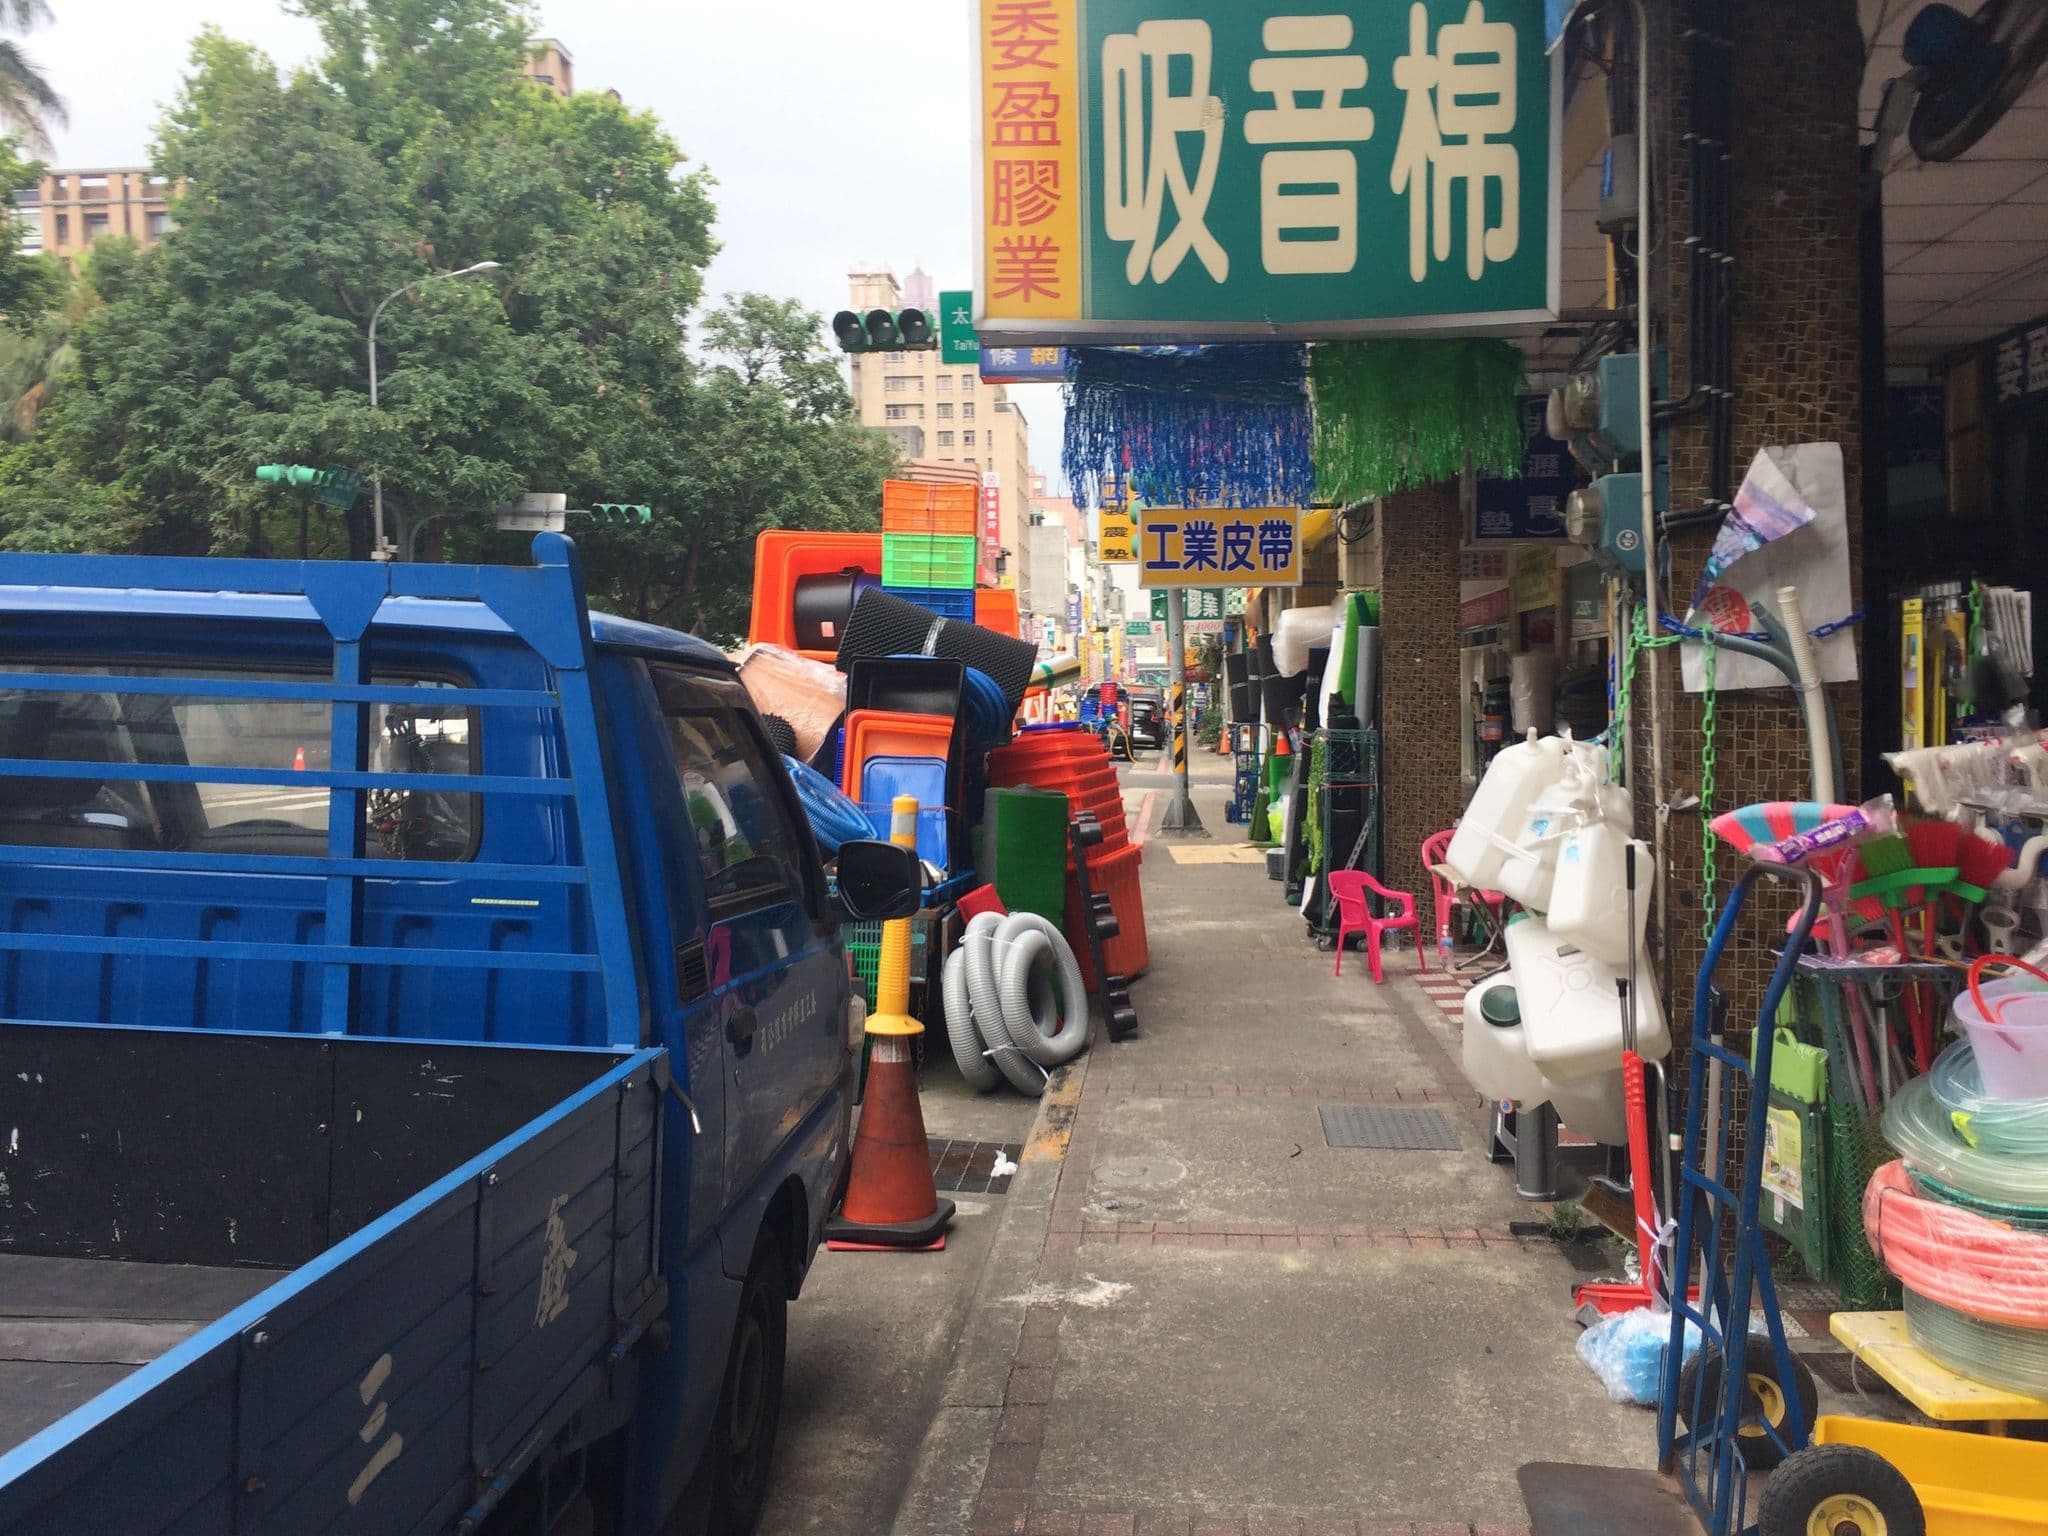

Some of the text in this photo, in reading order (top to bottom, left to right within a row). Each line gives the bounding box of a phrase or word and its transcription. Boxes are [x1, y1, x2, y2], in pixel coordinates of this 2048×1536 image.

[991, 1, 1061, 303] 委盈膠業
[1102, 0, 1520, 285] 吸音棉
[1146, 520, 1293, 571] 工業皮帶
[1182, 588, 1219, 618] 膠業
